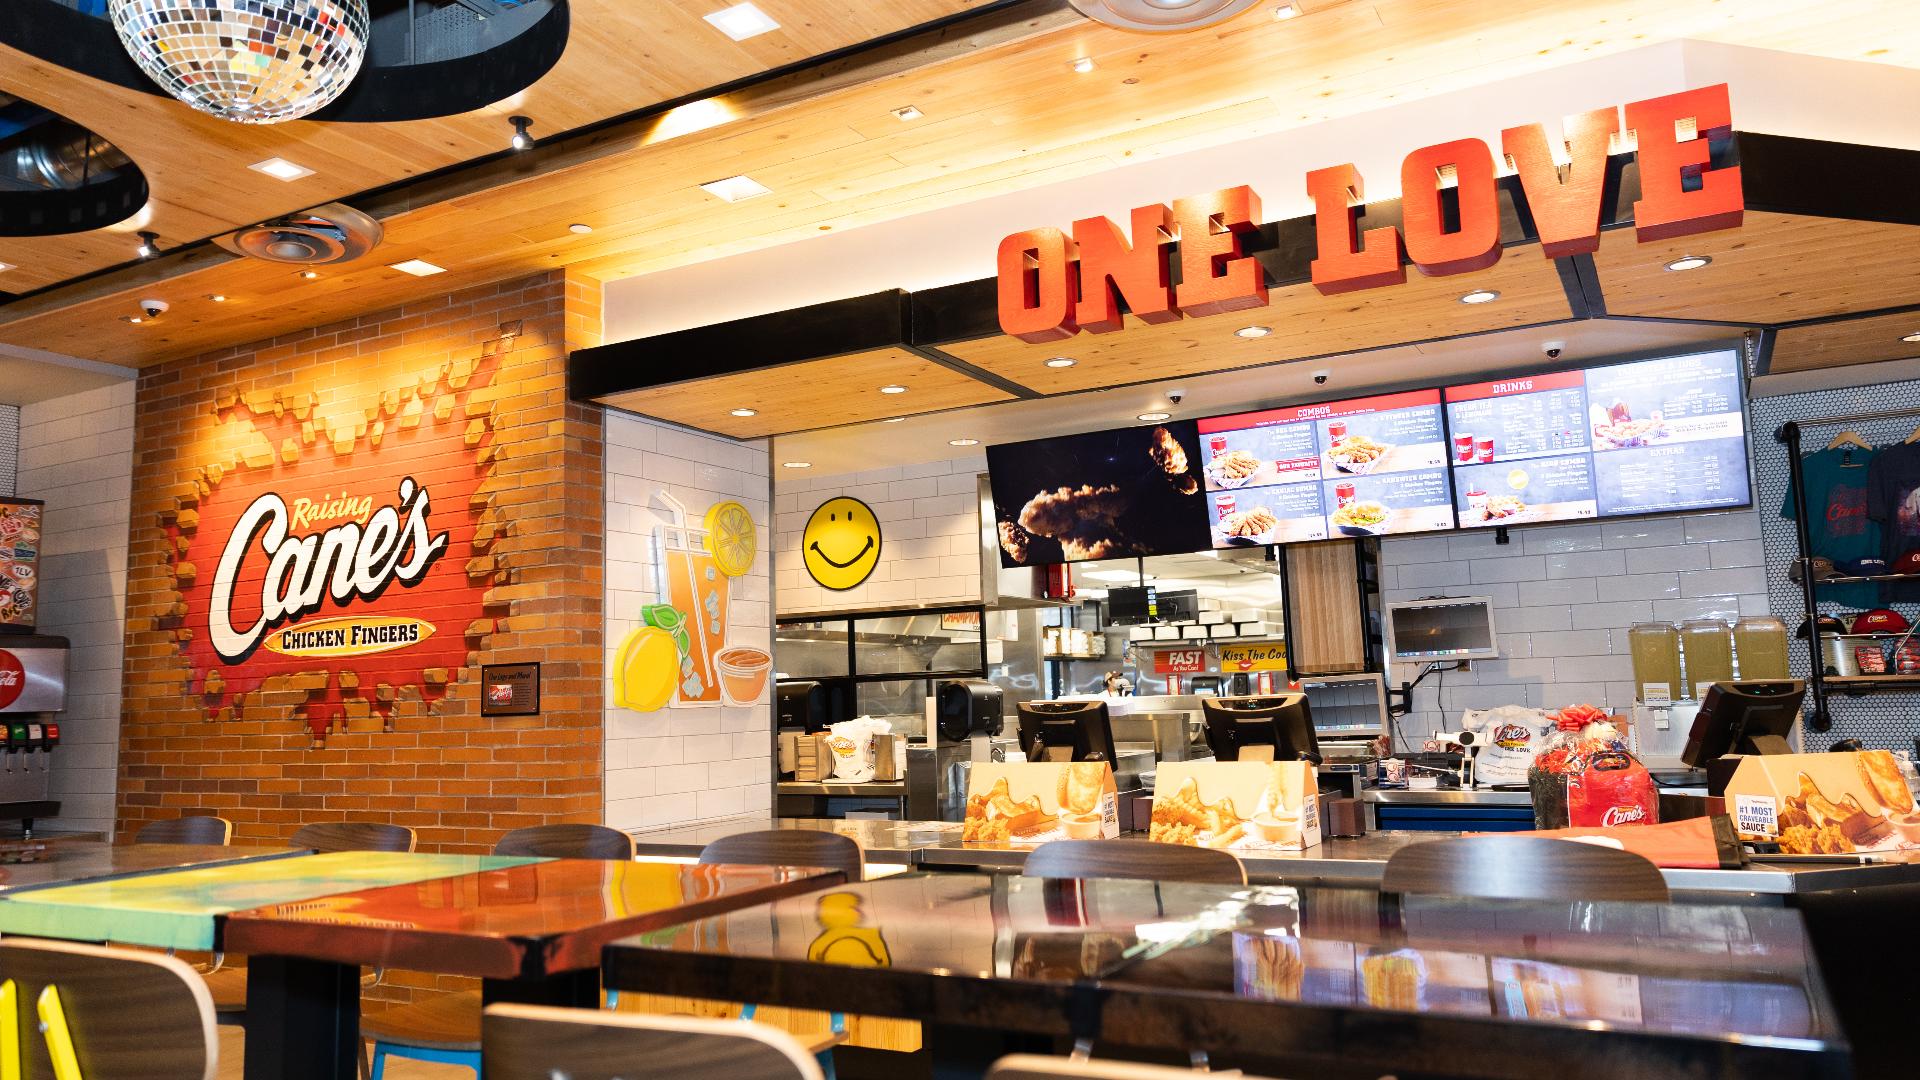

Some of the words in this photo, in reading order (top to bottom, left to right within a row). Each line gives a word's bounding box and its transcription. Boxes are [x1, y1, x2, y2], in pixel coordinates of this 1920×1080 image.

[996, 184, 1269, 344] ONE
[1306, 82, 1744, 296] LOVE
[1493, 380, 1533, 394] DRINKS
[1297, 406, 1331, 418] COMBOS
[290, 491, 373, 530] Raising
[14, 566, 32, 577] 1LV
[208, 476, 450, 665] Cane's
[282, 628, 345, 650] CHICKEN
[351, 624, 419, 647] FINGERS
[1168, 651, 1202, 666] FAST
[1222, 649, 1245, 661] Kiss
[1246, 648, 1265, 661] The
[1267, 647, 1287, 660] Coo
[1602, 804, 1646, 828] Cane's
[1739, 805, 1748, 815] #1
[1751, 806, 1773, 816] MOST
[1739, 814, 1774, 824] CRAVEABLE
[1740, 821, 1766, 833] SAUCE
